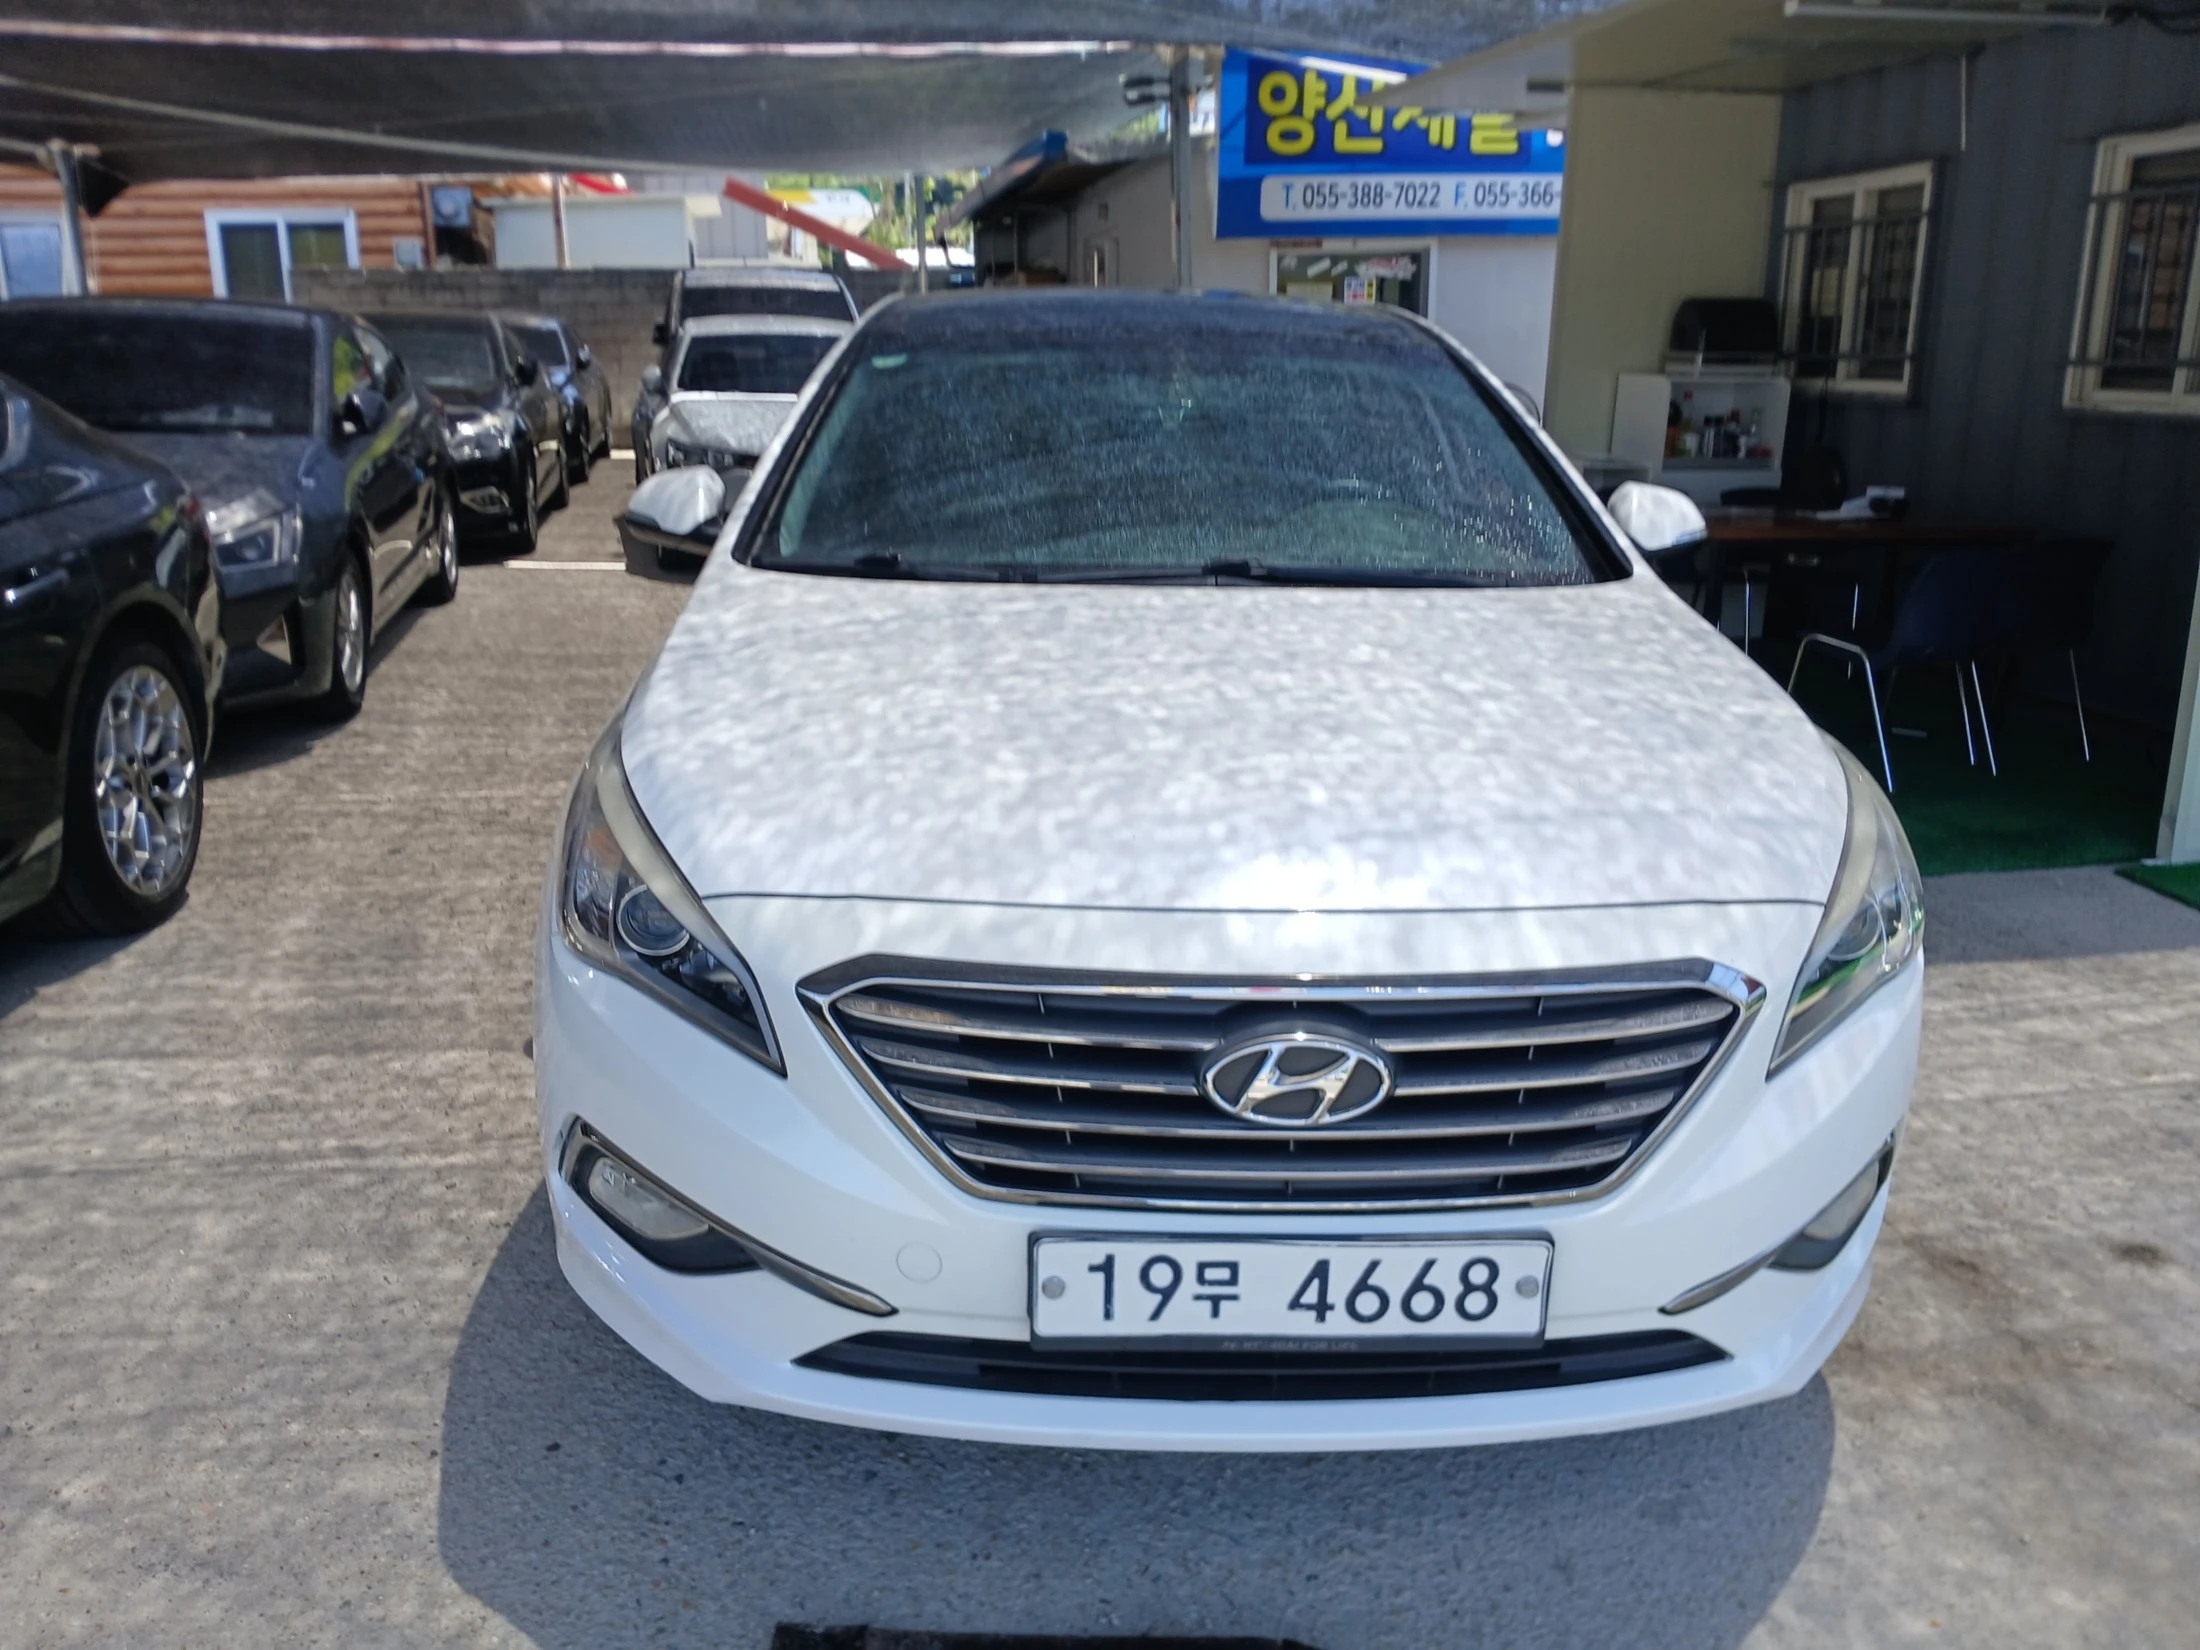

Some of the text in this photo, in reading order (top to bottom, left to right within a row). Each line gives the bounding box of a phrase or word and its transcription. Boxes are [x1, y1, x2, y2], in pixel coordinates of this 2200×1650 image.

[1302, 181, 1441, 210] 055-388-7022
[1087, 1253, 1500, 1323] 19무 4668
